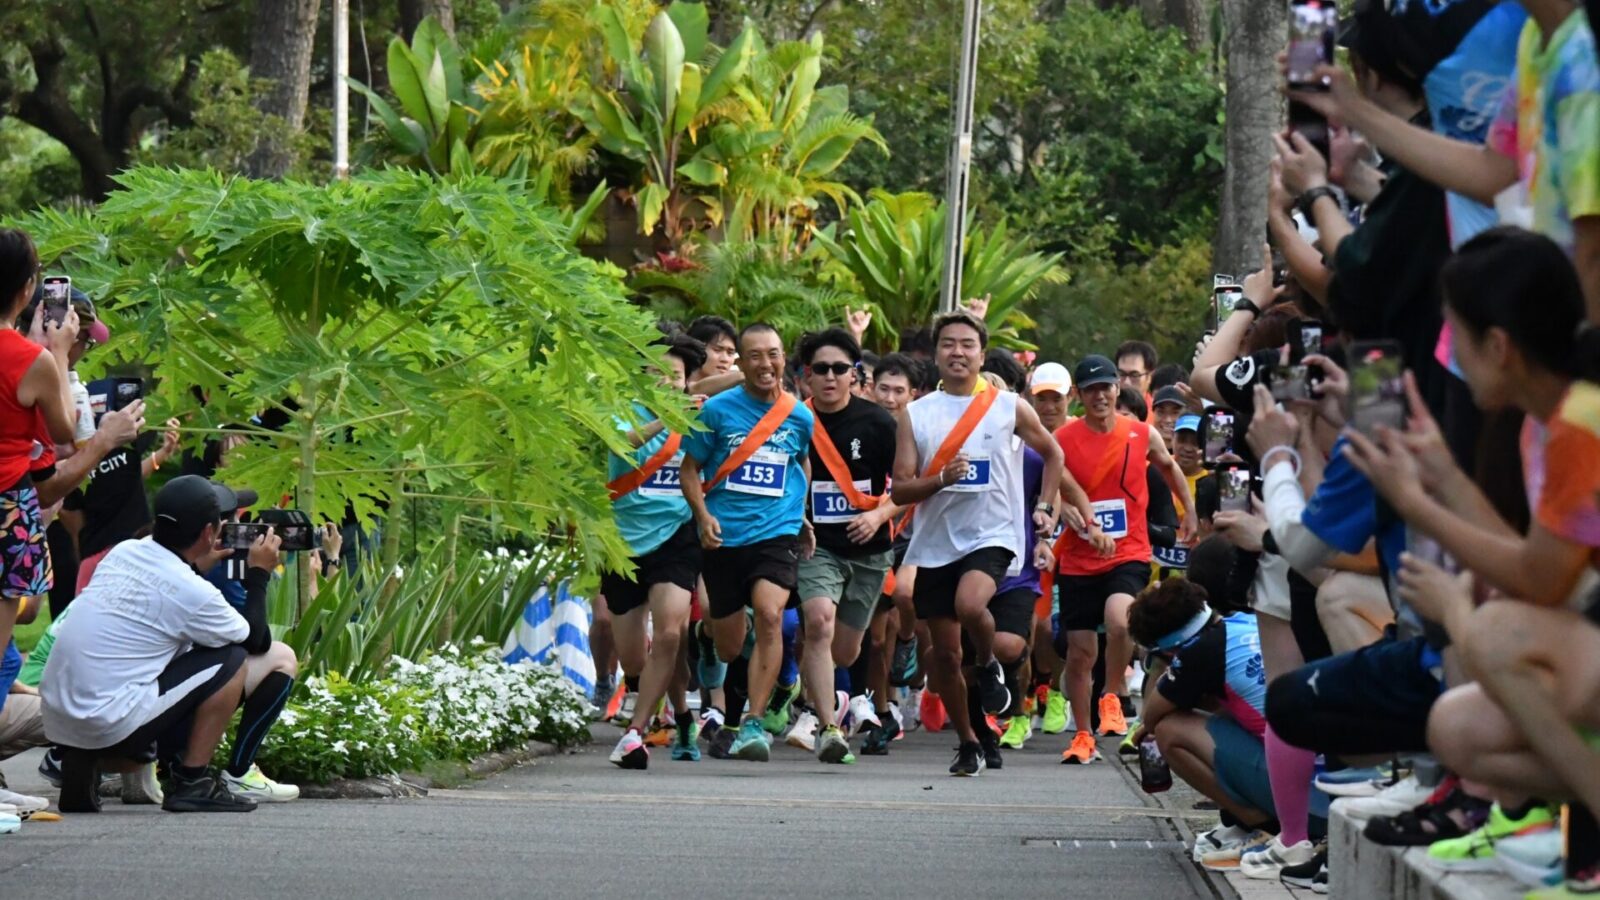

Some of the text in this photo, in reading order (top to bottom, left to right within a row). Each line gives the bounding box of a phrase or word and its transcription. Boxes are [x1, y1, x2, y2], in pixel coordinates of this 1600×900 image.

[99, 452, 128, 473] CITY
[741, 465, 775, 484] 153
[1159, 546, 1187, 561] 113
[146, 571, 181, 597] FACE
